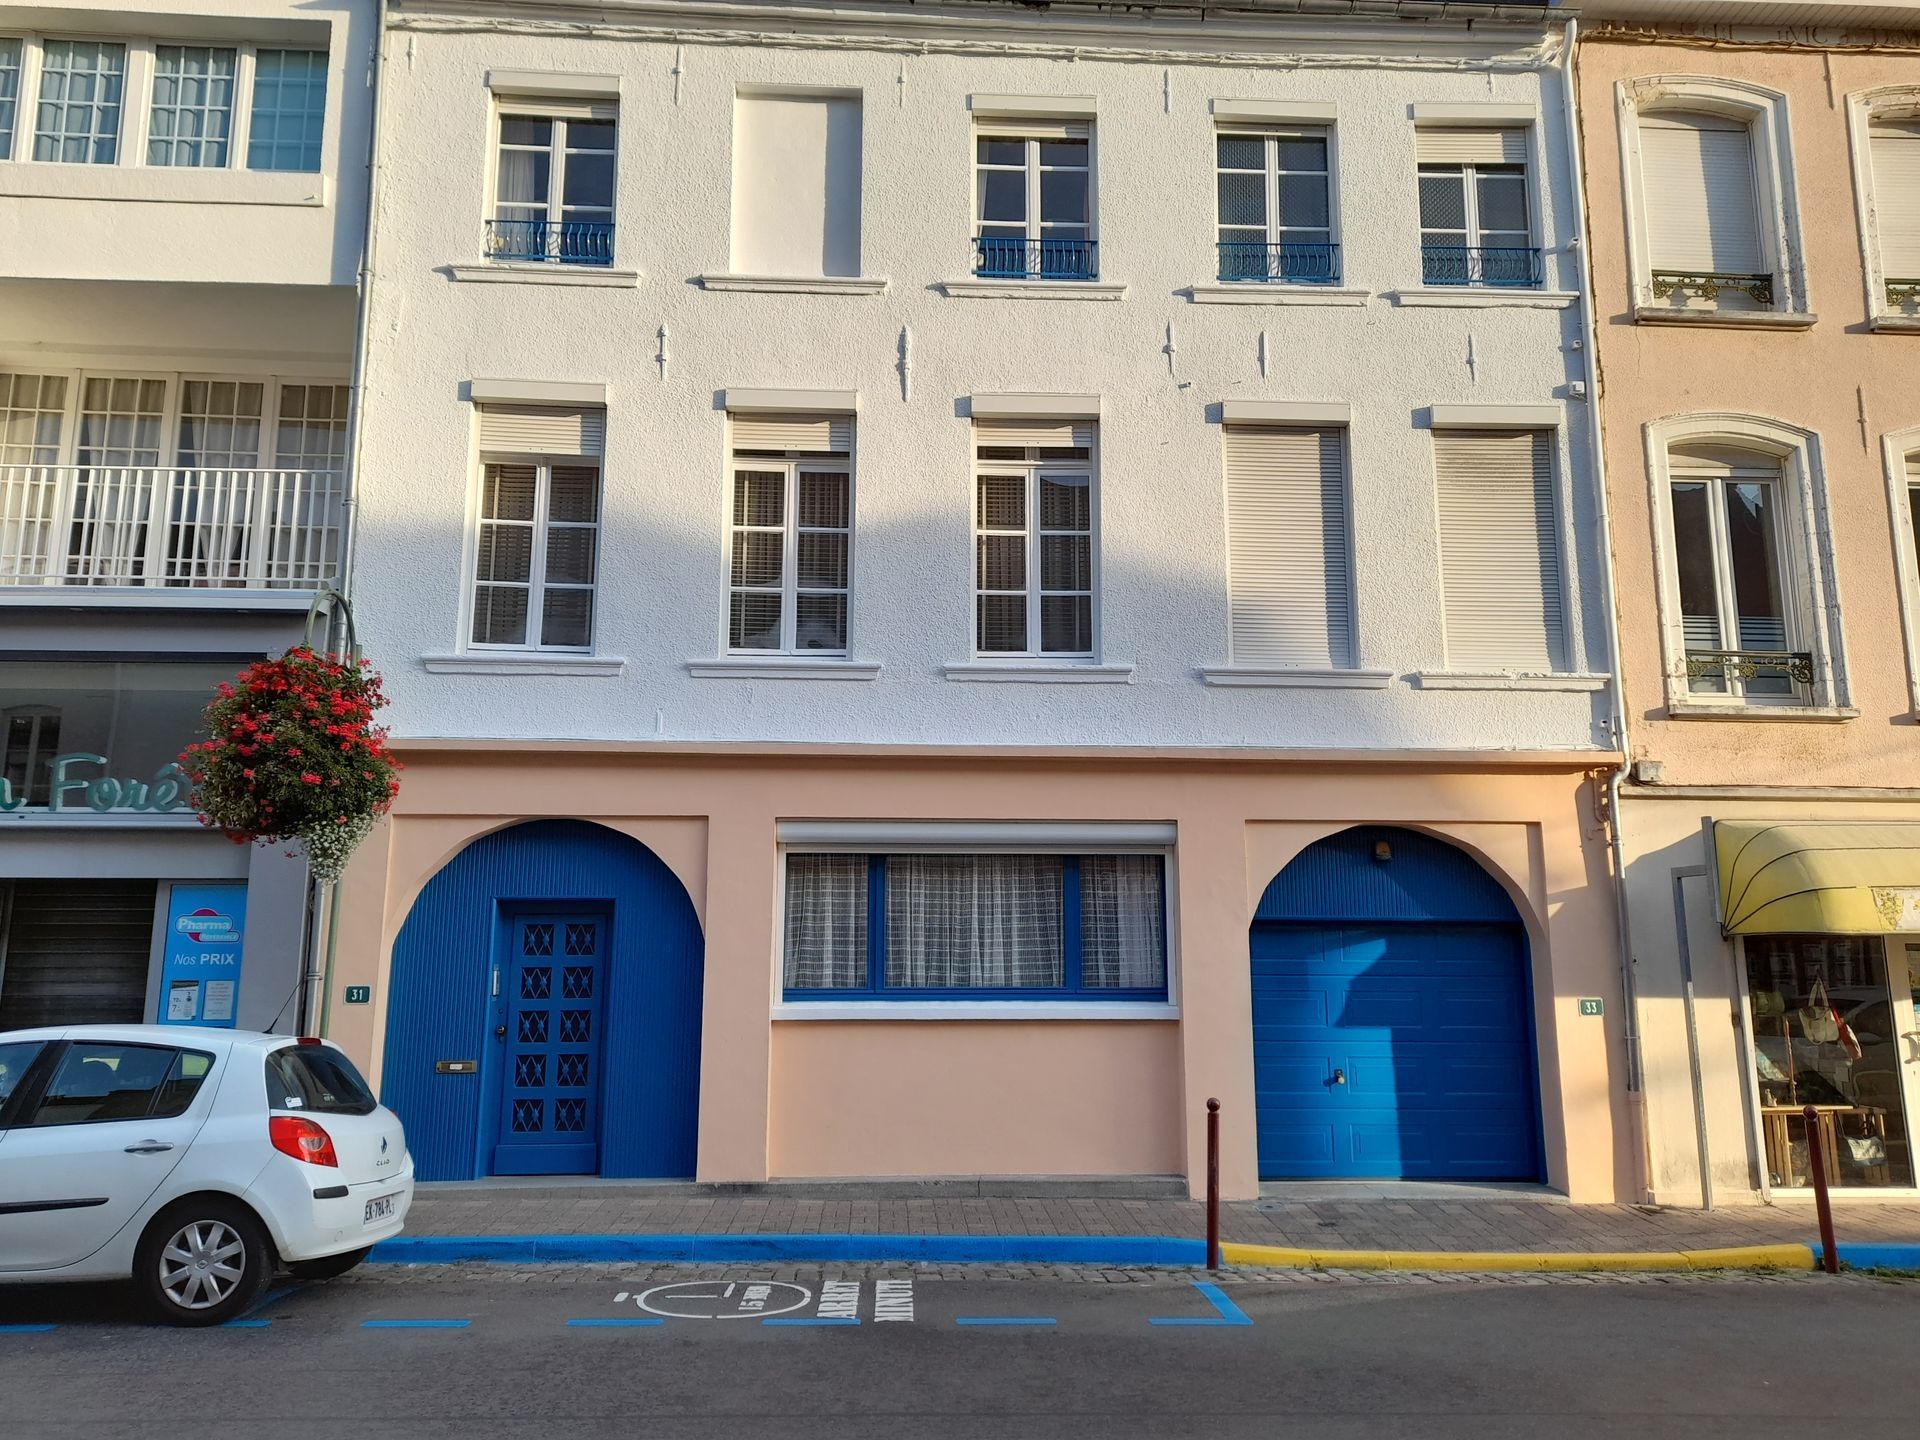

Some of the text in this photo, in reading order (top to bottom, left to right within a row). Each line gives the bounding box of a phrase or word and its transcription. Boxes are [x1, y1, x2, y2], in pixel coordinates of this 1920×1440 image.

[49, 752, 197, 812] Forê
[178, 917, 230, 930] Pharma
[174, 953, 234, 965] Nos PRIX
[351, 989, 363, 1001] 31
[1585, 1002, 1597, 1014] 33
[376, 1158, 390, 1167] CLIO
[816, 1279, 860, 1320] ARRET
